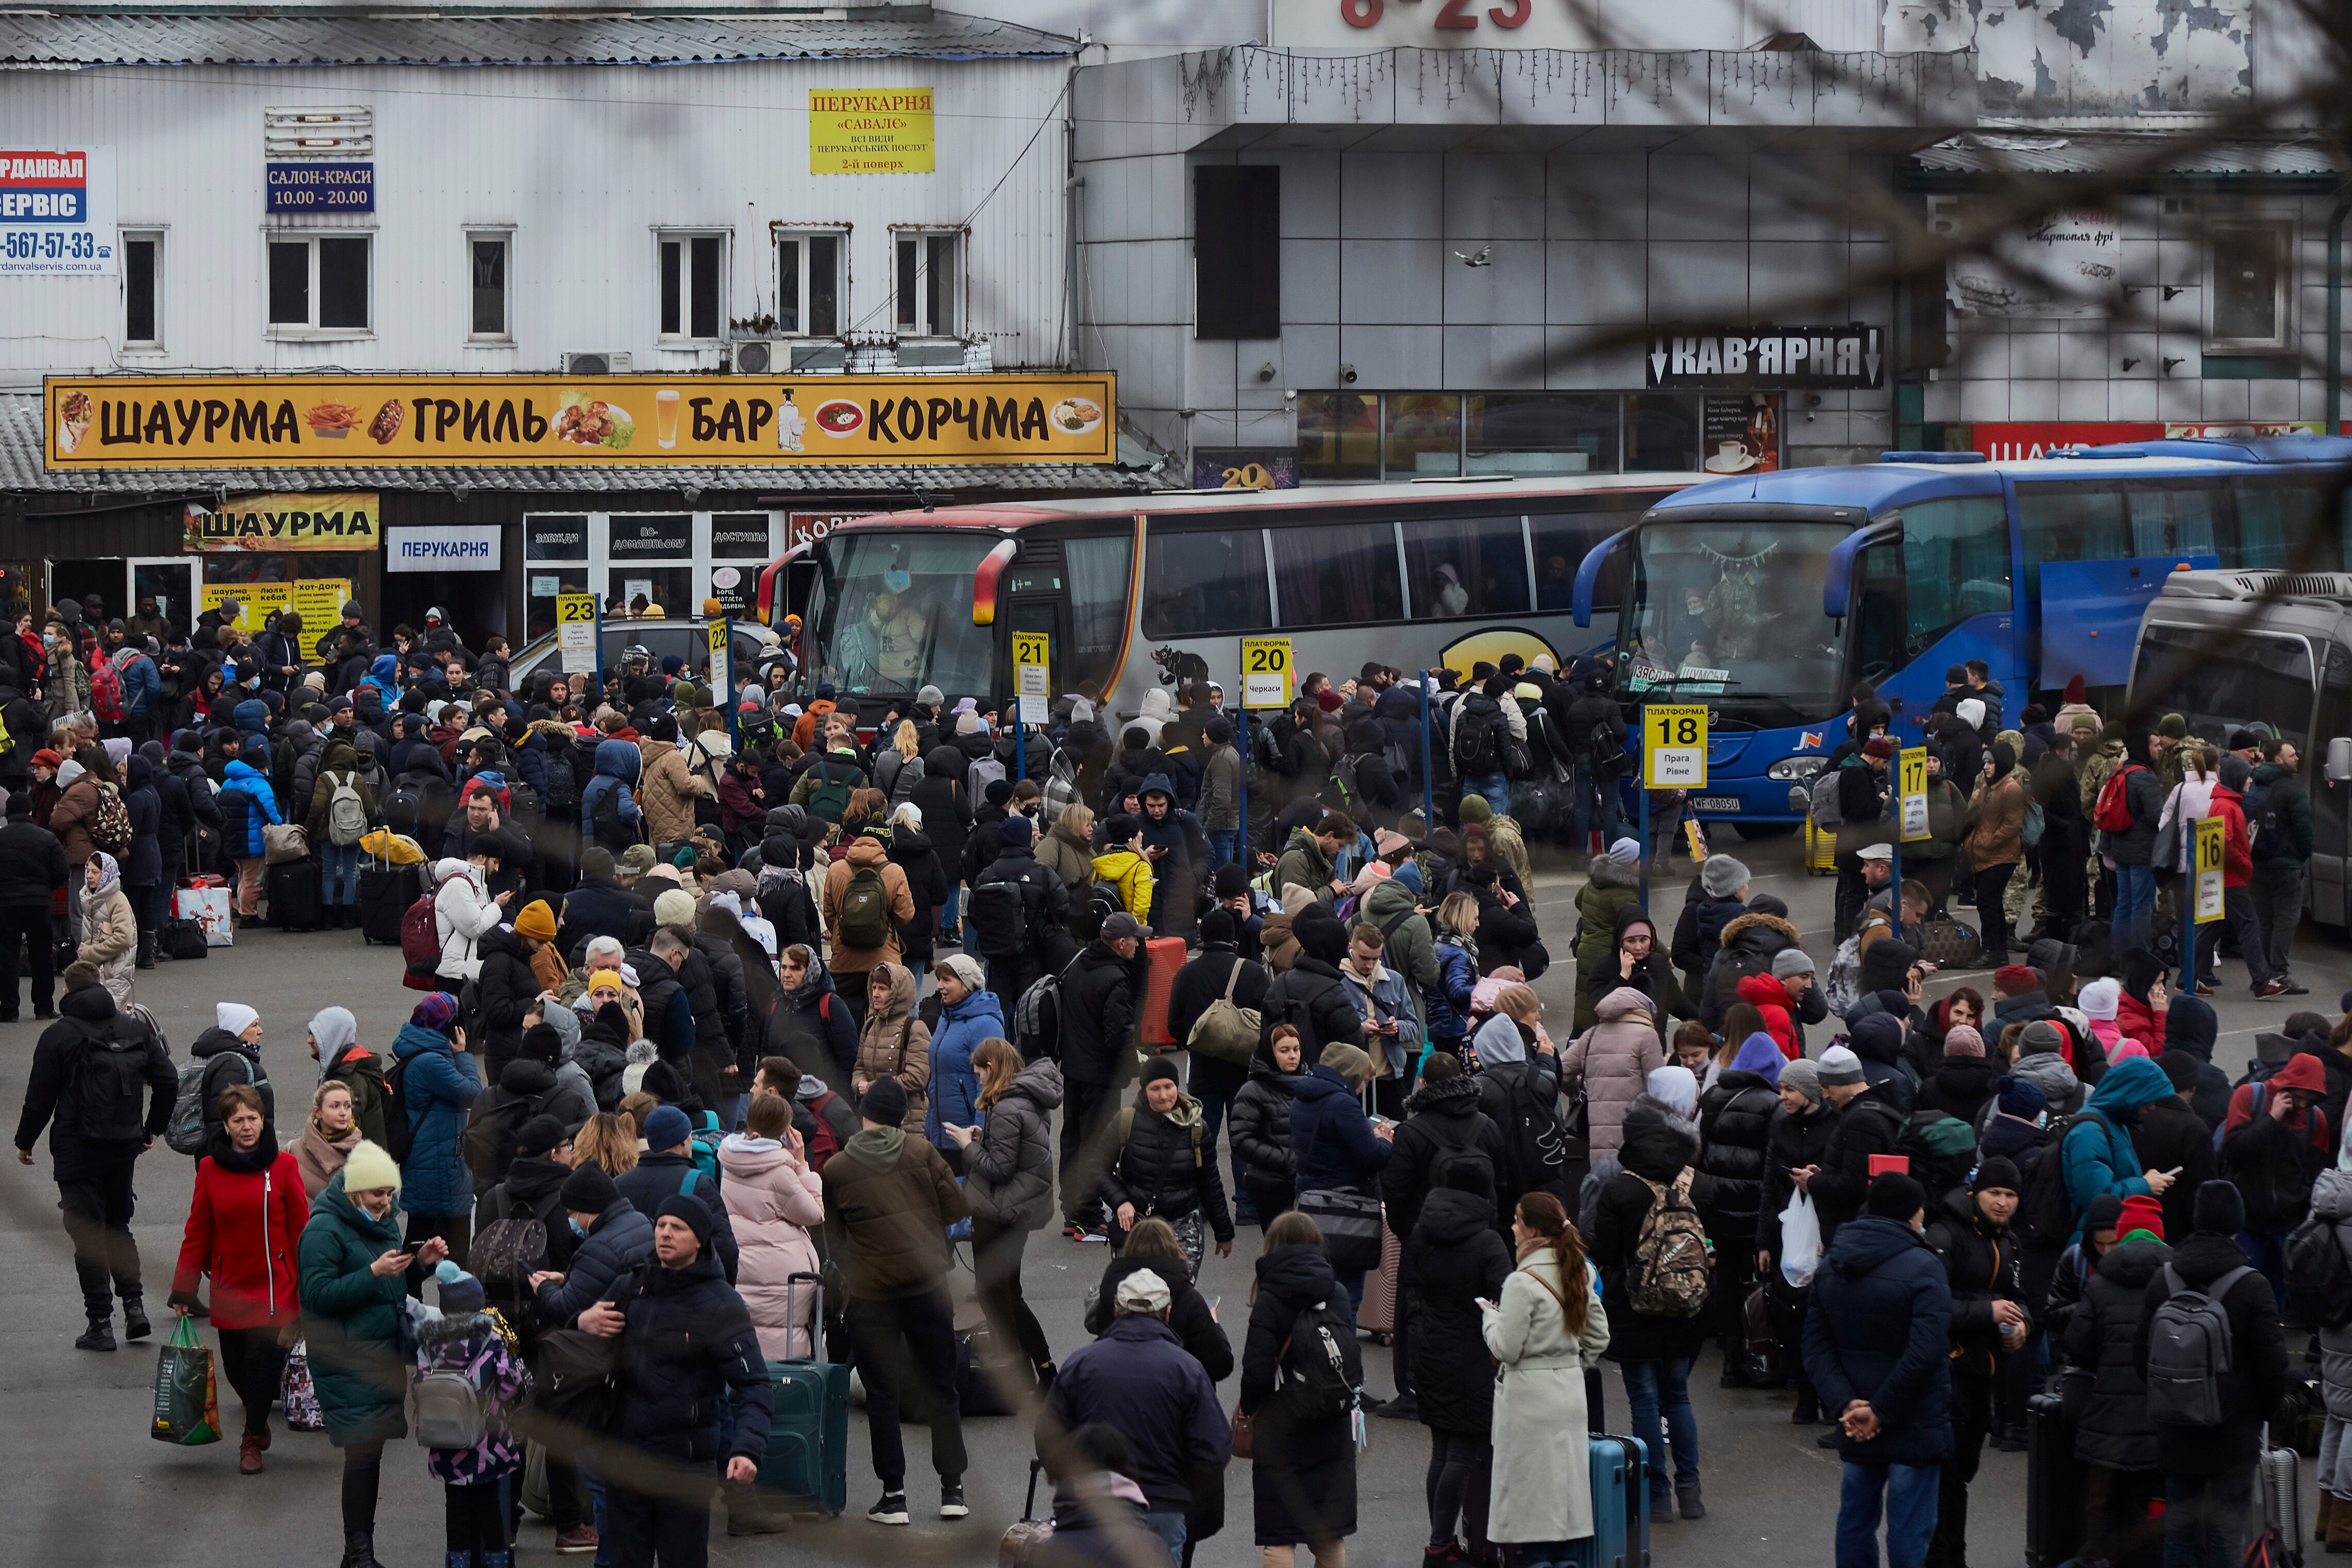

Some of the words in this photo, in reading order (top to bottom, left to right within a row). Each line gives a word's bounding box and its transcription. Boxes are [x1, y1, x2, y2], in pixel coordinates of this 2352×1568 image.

[812, 95, 932, 111] ПЕРУКАРНЯ
[837, 119, 907, 129] «САВАЛЄ»
[868, 135, 894, 143] ВИДИ
[818, 144, 889, 153] ПЕРУКАРСЬКИХ
[842, 159, 859, 169] 2-й
[863, 161, 903, 170] поверх
[269, 170, 371, 185] САЛОН-КРАСИ
[0, 193, 76, 217] ЕРВІС
[275, 192, 314, 204] 10.00
[328, 191, 368, 203] 20.00
[101, 399, 300, 444] ШАУРМА
[413, 398, 547, 443] ГРИЛЬ
[689, 397, 772, 442] БАР
[868, 396, 1051, 441] КОРЧМА
[202, 510, 373, 537] ШАУРМА
[535, 533, 579, 543] ЗАВЖДИ
[640, 527, 658, 537] ПО-
[713, 532, 767, 543] ДОСТУПНО
[402, 541, 489, 557] ПЕРУКАРНЯ
[613, 538, 686, 550] ДОМАШНЬОМУ
[565, 602, 595, 620] 23
[712, 628, 726, 650] 22
[1019, 642, 1041, 663] 21
[1251, 650, 1285, 671] 20
[1249, 685, 1280, 693] Черкаси
[1658, 719, 1698, 744] 18
[1666, 767, 1689, 775] Рівне
[1906, 763, 1922, 791] 17
[2202, 833, 2219, 867] 16
